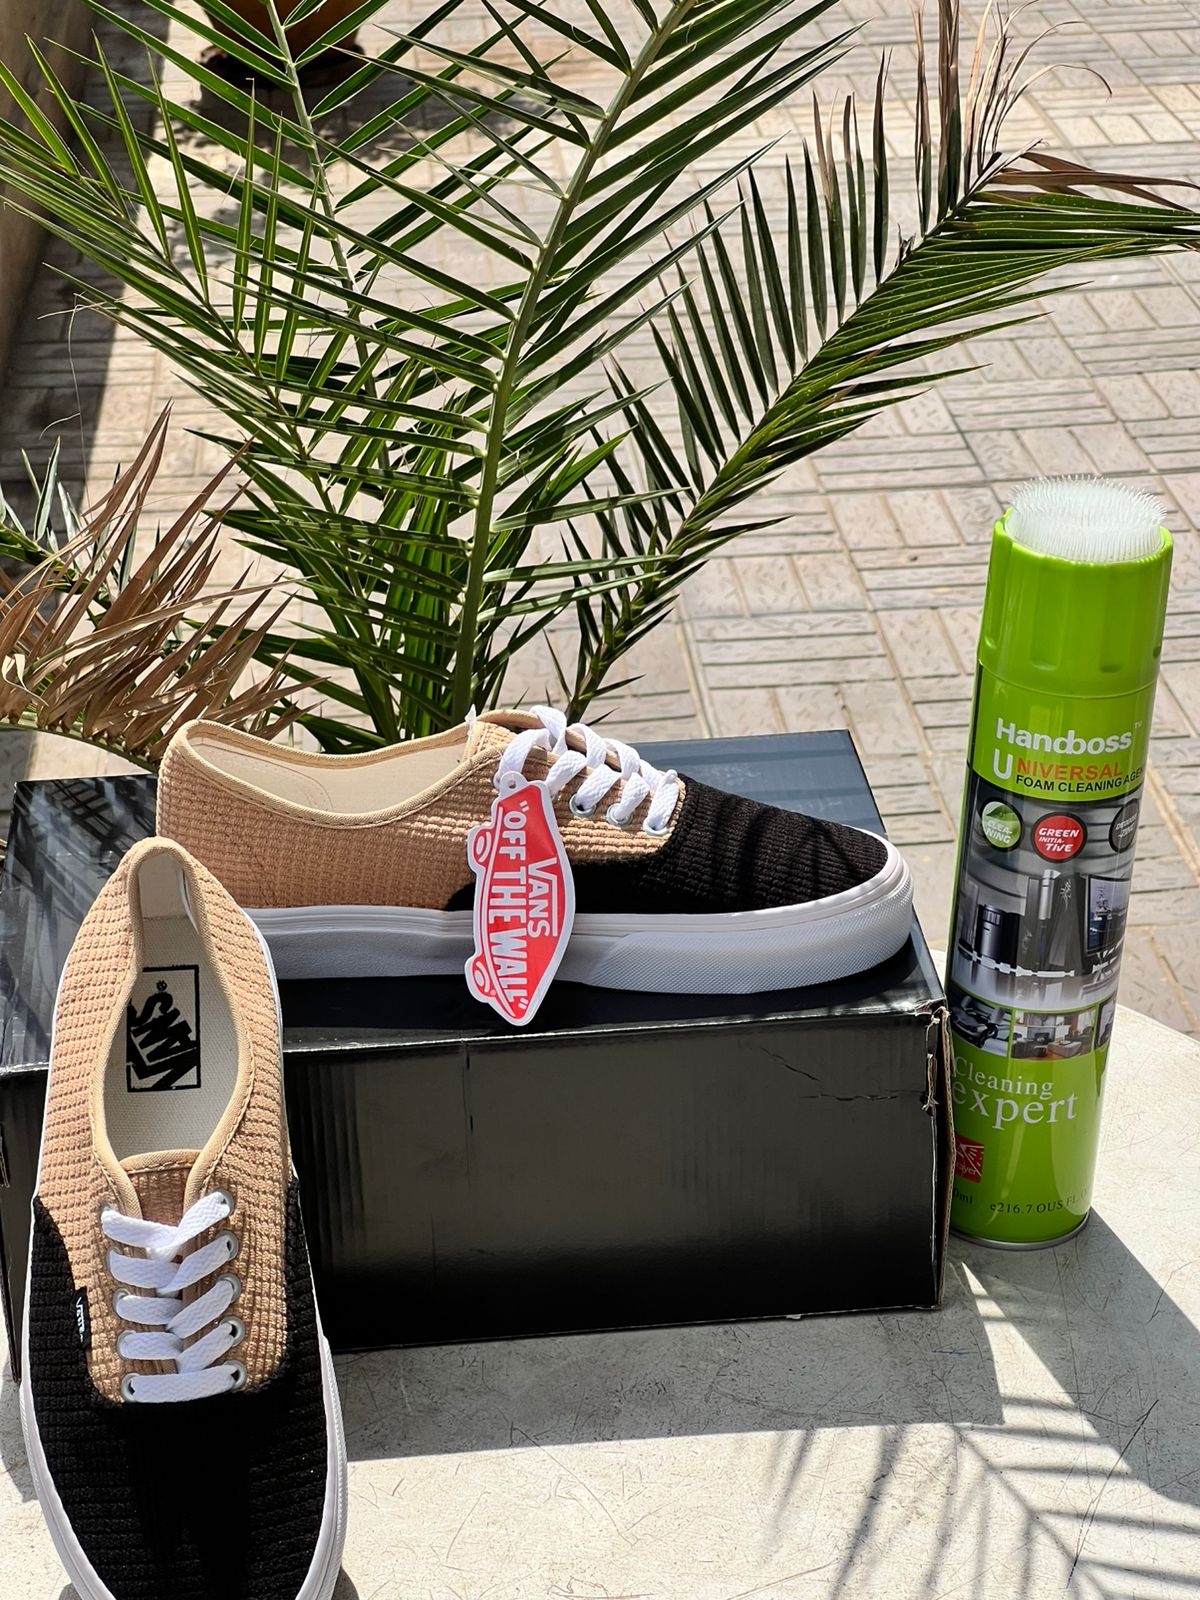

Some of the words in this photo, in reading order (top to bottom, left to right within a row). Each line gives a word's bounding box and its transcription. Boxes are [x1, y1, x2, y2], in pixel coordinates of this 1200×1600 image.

[996, 717, 1132, 754] Handboss
[1016, 774, 1054, 791] FOAM
[1058, 777, 1122, 793] CLEANING
[986, 828, 1011, 844] NING
[1038, 827, 1080, 838] GREEN
[1038, 836, 1065, 844] INITIA-
[1045, 843, 1074, 852] TIVE
[487, 864, 527, 925] THE
[527, 856, 559, 938] VANS
[952, 1055, 1054, 1100] Cleaning
[952, 1080, 1078, 1131] expert
